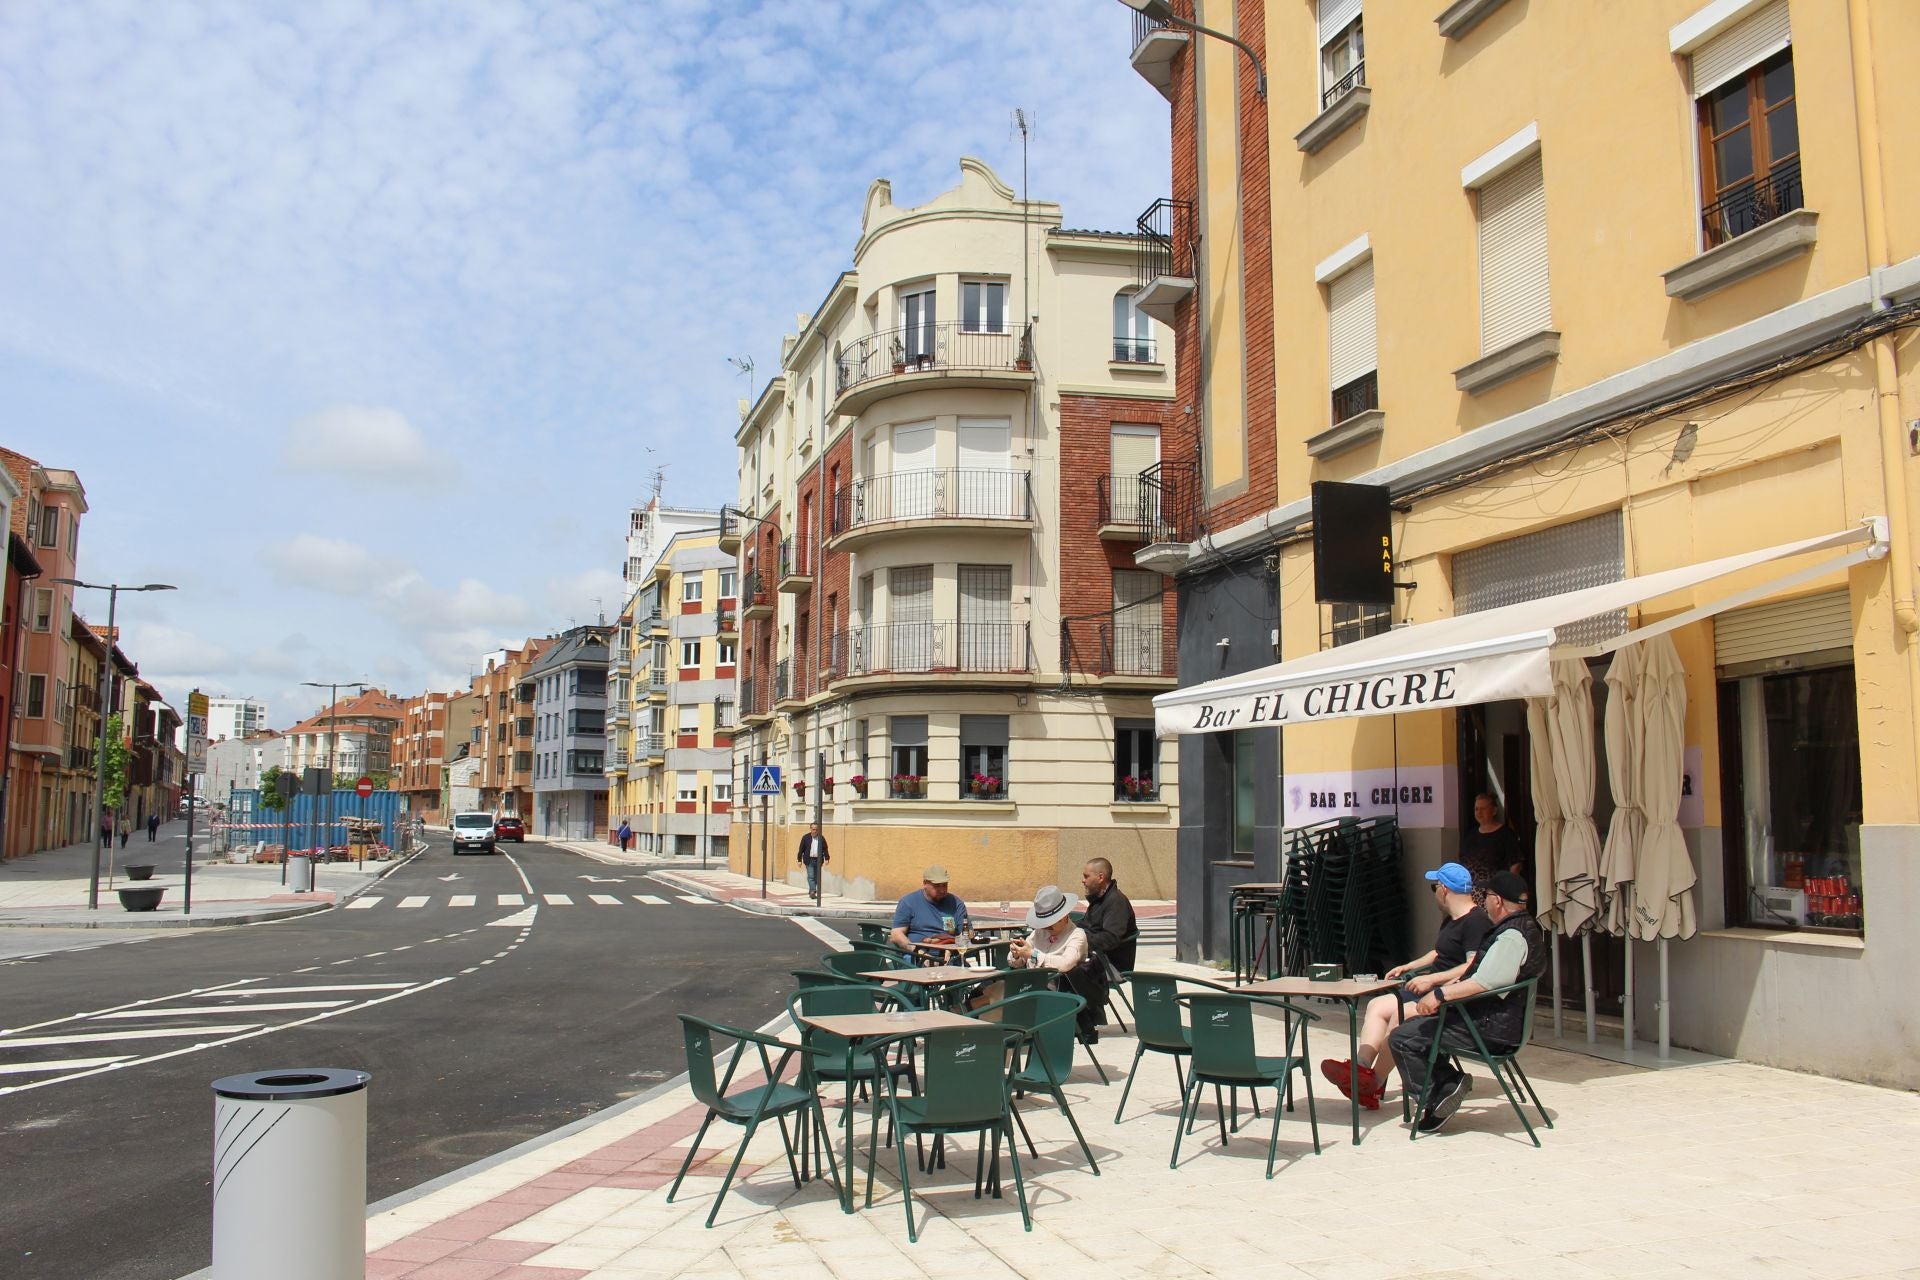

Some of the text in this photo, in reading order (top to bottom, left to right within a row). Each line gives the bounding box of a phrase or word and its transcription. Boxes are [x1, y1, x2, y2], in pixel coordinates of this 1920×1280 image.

[1382, 536, 1391, 574] BAR
[1193, 667, 1456, 729] Bar EL CHIGRE
[1310, 786, 1433, 808] BAR EL CHIGRE
